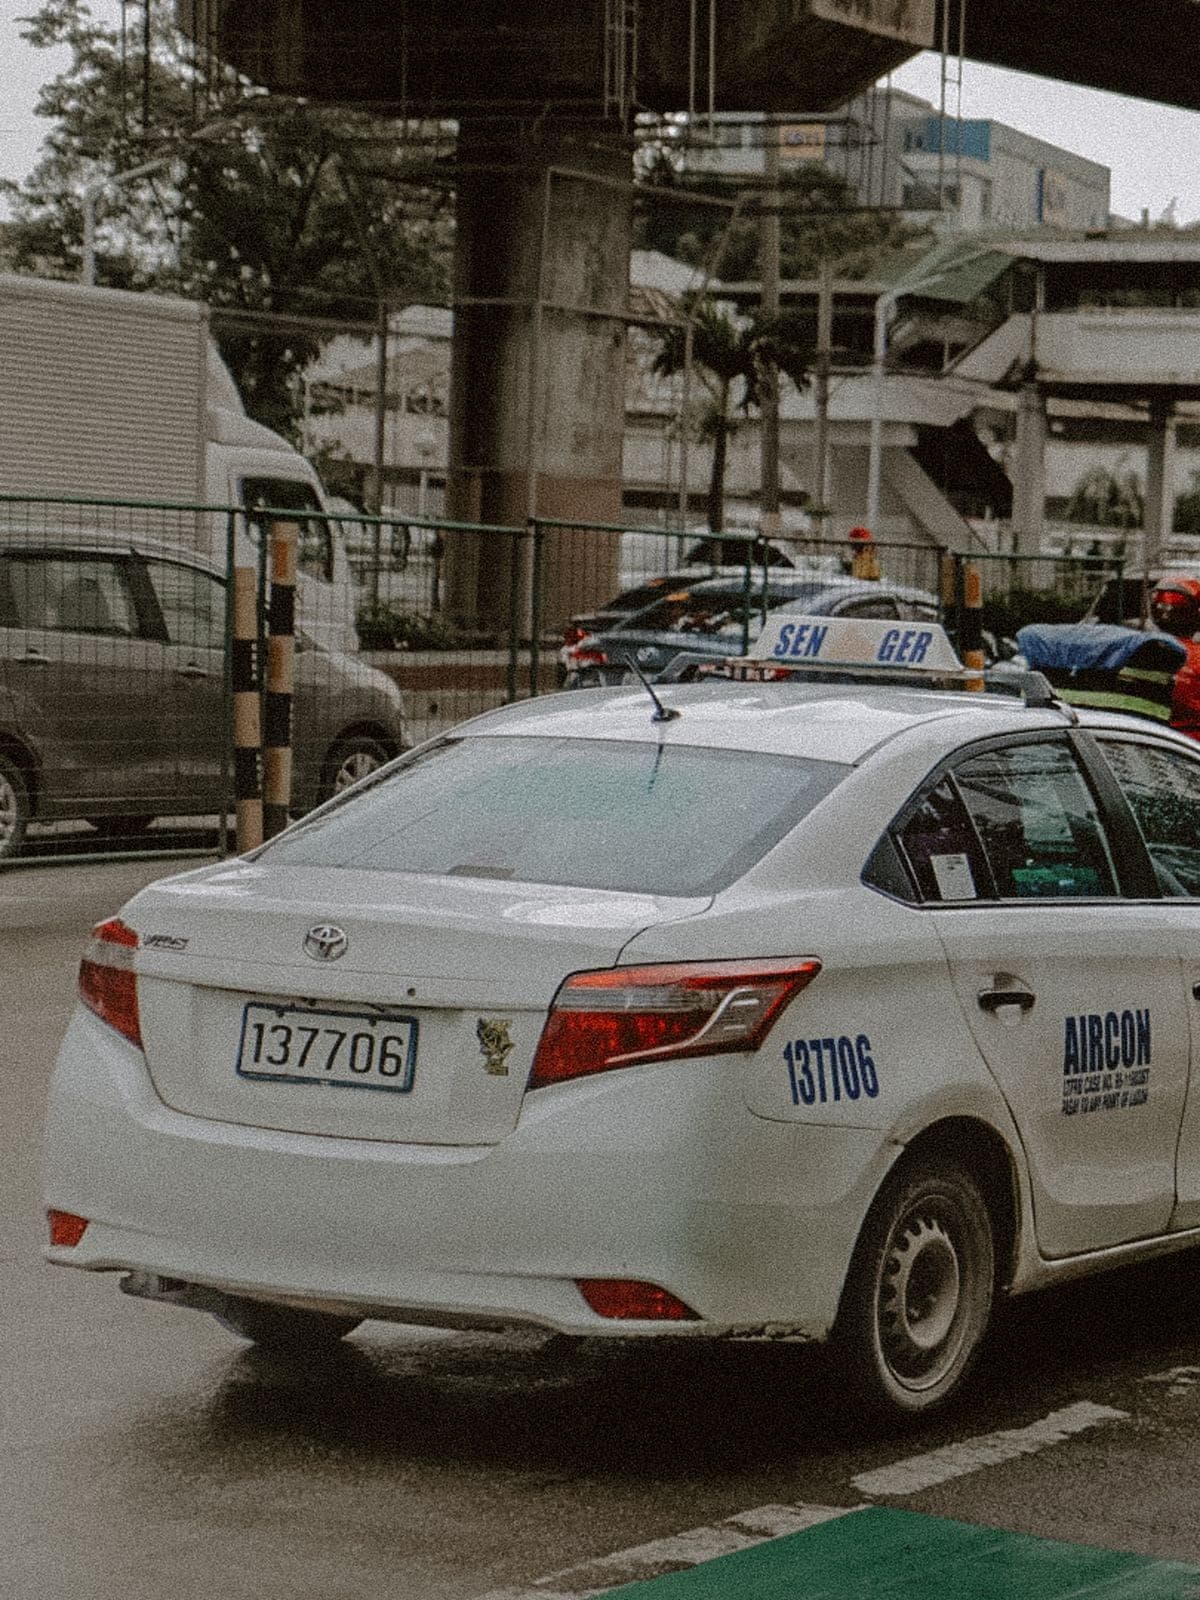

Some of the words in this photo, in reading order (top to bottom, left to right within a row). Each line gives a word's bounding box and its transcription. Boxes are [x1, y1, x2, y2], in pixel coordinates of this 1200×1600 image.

[774, 624, 828, 657] SEN
[876, 629, 933, 663] GER
[252, 1022, 404, 1077] 137706
[783, 1034, 880, 1105] 137706
[1063, 1008, 1151, 1076] AIRCON
